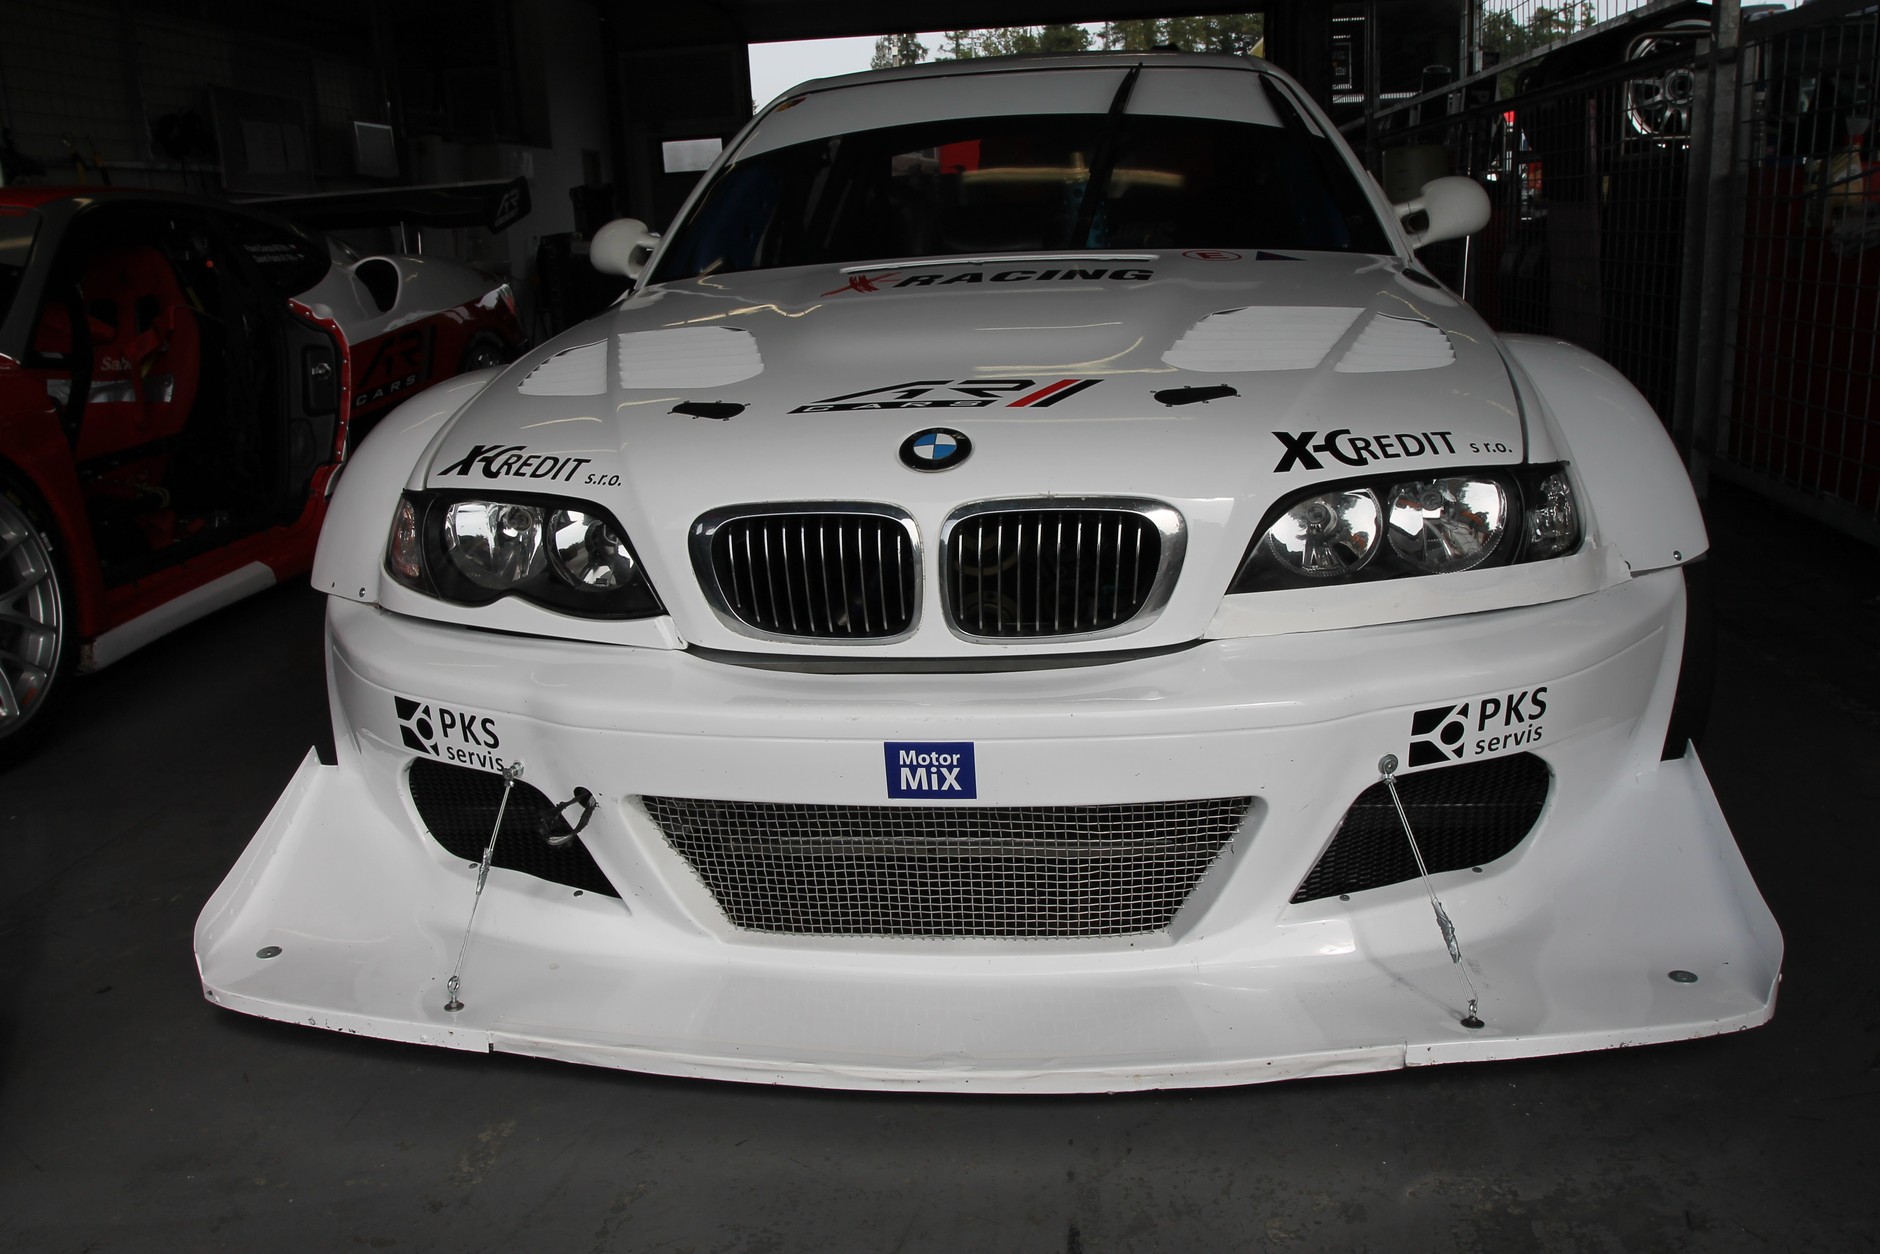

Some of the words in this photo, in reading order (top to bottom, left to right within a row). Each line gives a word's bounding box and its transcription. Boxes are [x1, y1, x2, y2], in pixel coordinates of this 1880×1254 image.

[894, 269, 1155, 288] RACING
[355, 374, 417, 407] CARS
[802, 400, 982, 413] CARS
[584, 473, 622, 487] s.r.o.
[1478, 686, 1548, 732] PKS
[439, 707, 500, 749] PKS
[1474, 723, 1543, 755] servis
[446, 746, 504, 772] servis
[899, 749, 961, 766] Motor
[900, 766, 963, 791] MiX
